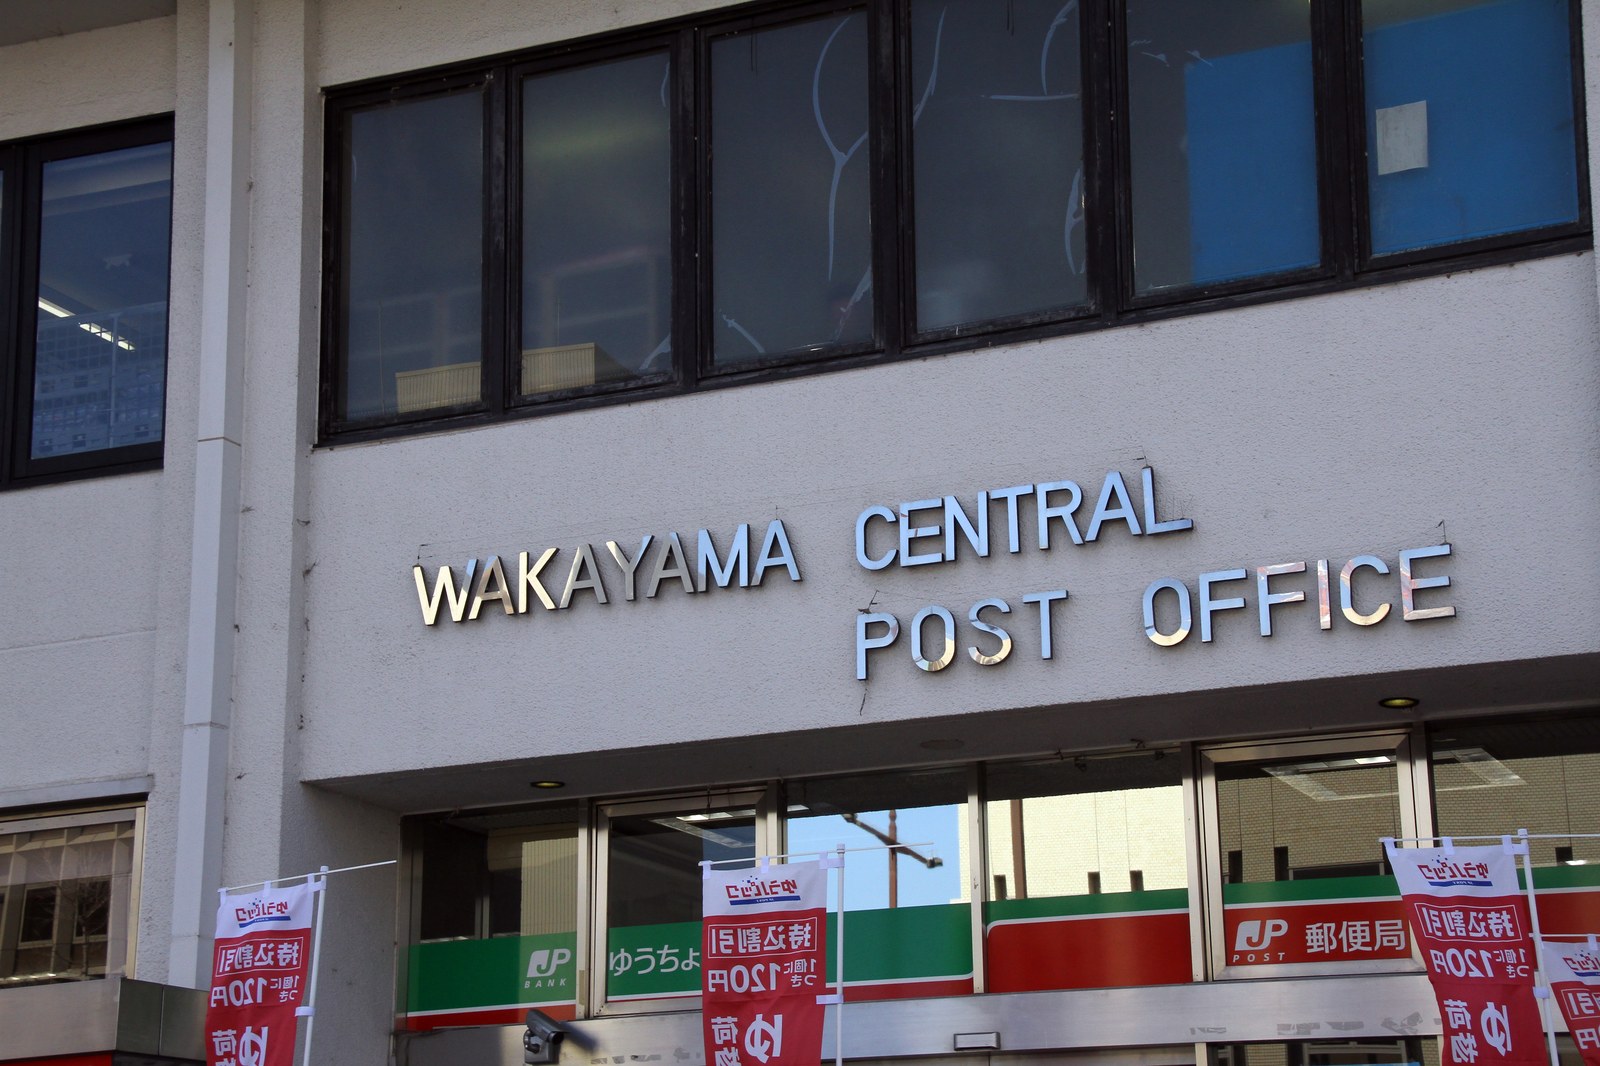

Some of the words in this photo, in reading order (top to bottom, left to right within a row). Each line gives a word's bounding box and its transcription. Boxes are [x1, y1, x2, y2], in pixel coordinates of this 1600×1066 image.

[413, 519, 801, 626] WAKAYAMA
[855, 466, 1194, 571] CENTRAL
[856, 590, 1069, 681] POST
[1142, 543, 1457, 647] OFFICE
[1305, 919, 1406, 954] 郵便局
[609, 944, 700, 976] ゆうちょ
[1232, 952, 1286, 963] POST
[524, 978, 567, 989] BANK
